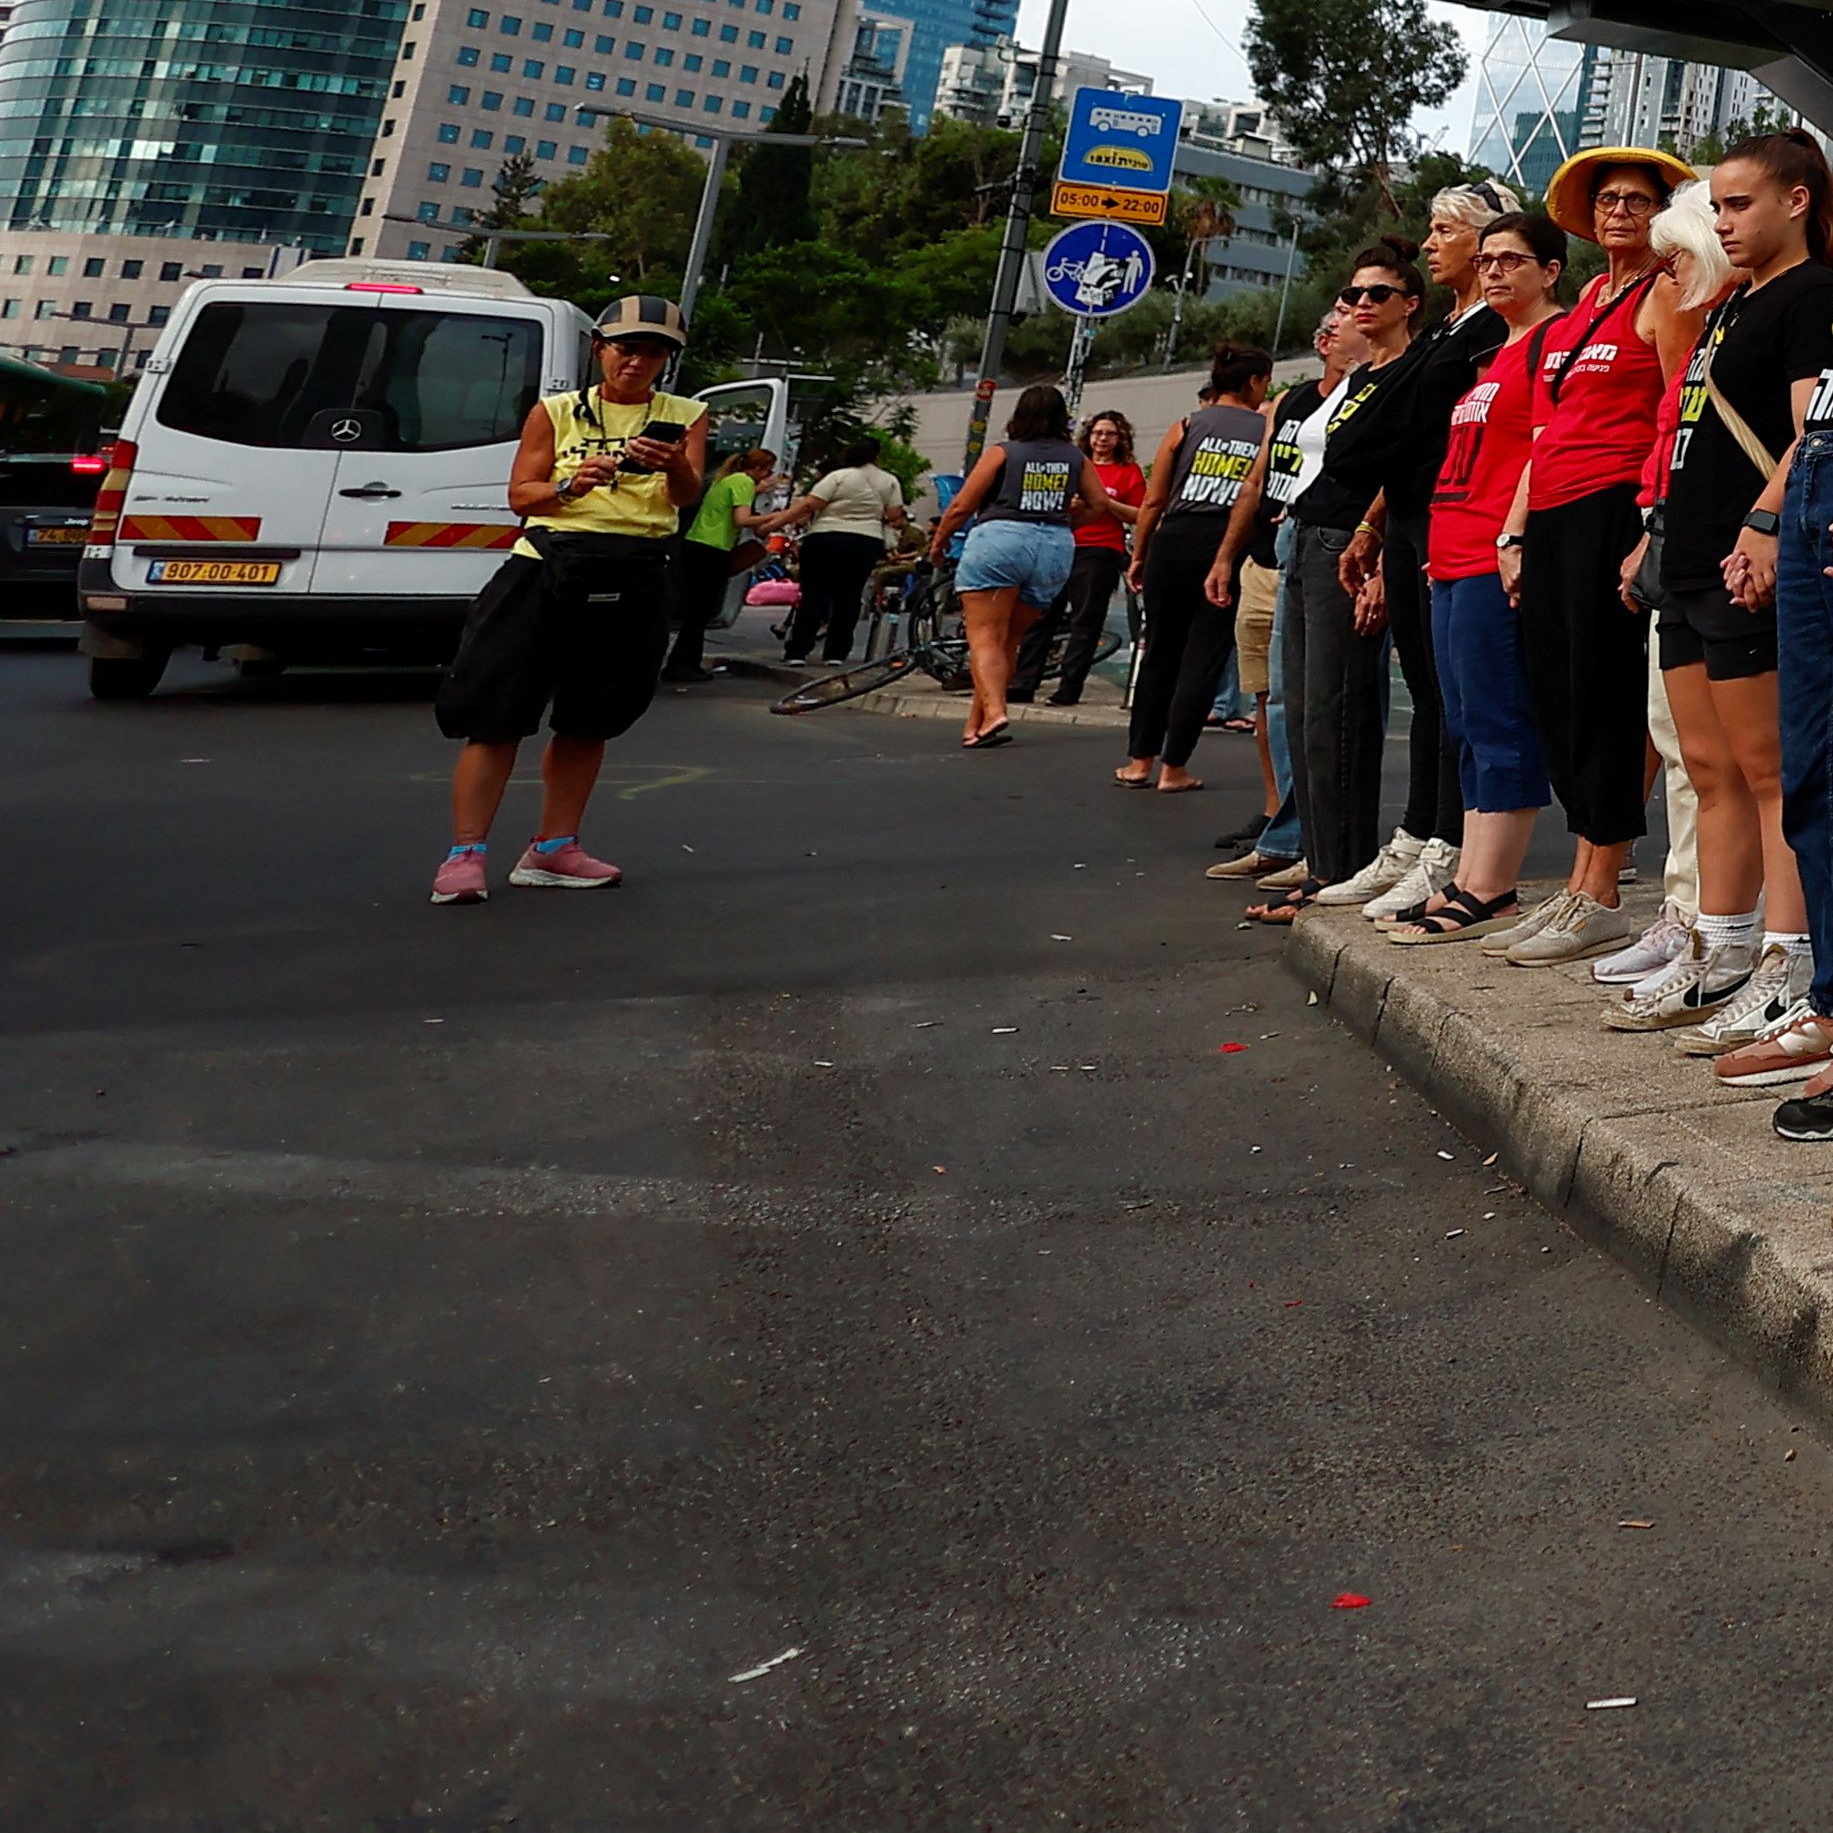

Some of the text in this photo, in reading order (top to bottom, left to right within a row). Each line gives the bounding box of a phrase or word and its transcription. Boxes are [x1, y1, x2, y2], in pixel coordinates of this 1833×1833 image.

[1060, 192, 1159, 214] 05:00 22:00
[1199, 437, 1222, 453] ALL
[1228, 439, 1260, 459] THEM
[1025, 461, 1042, 474] ALL
[1045, 462, 1070, 475] THEM
[1191, 450, 1253, 481] HOME!
[1022, 474, 1068, 491] HOME!
[1181, 473, 1243, 506] NOW!
[1019, 491, 1065, 511] NOW!
